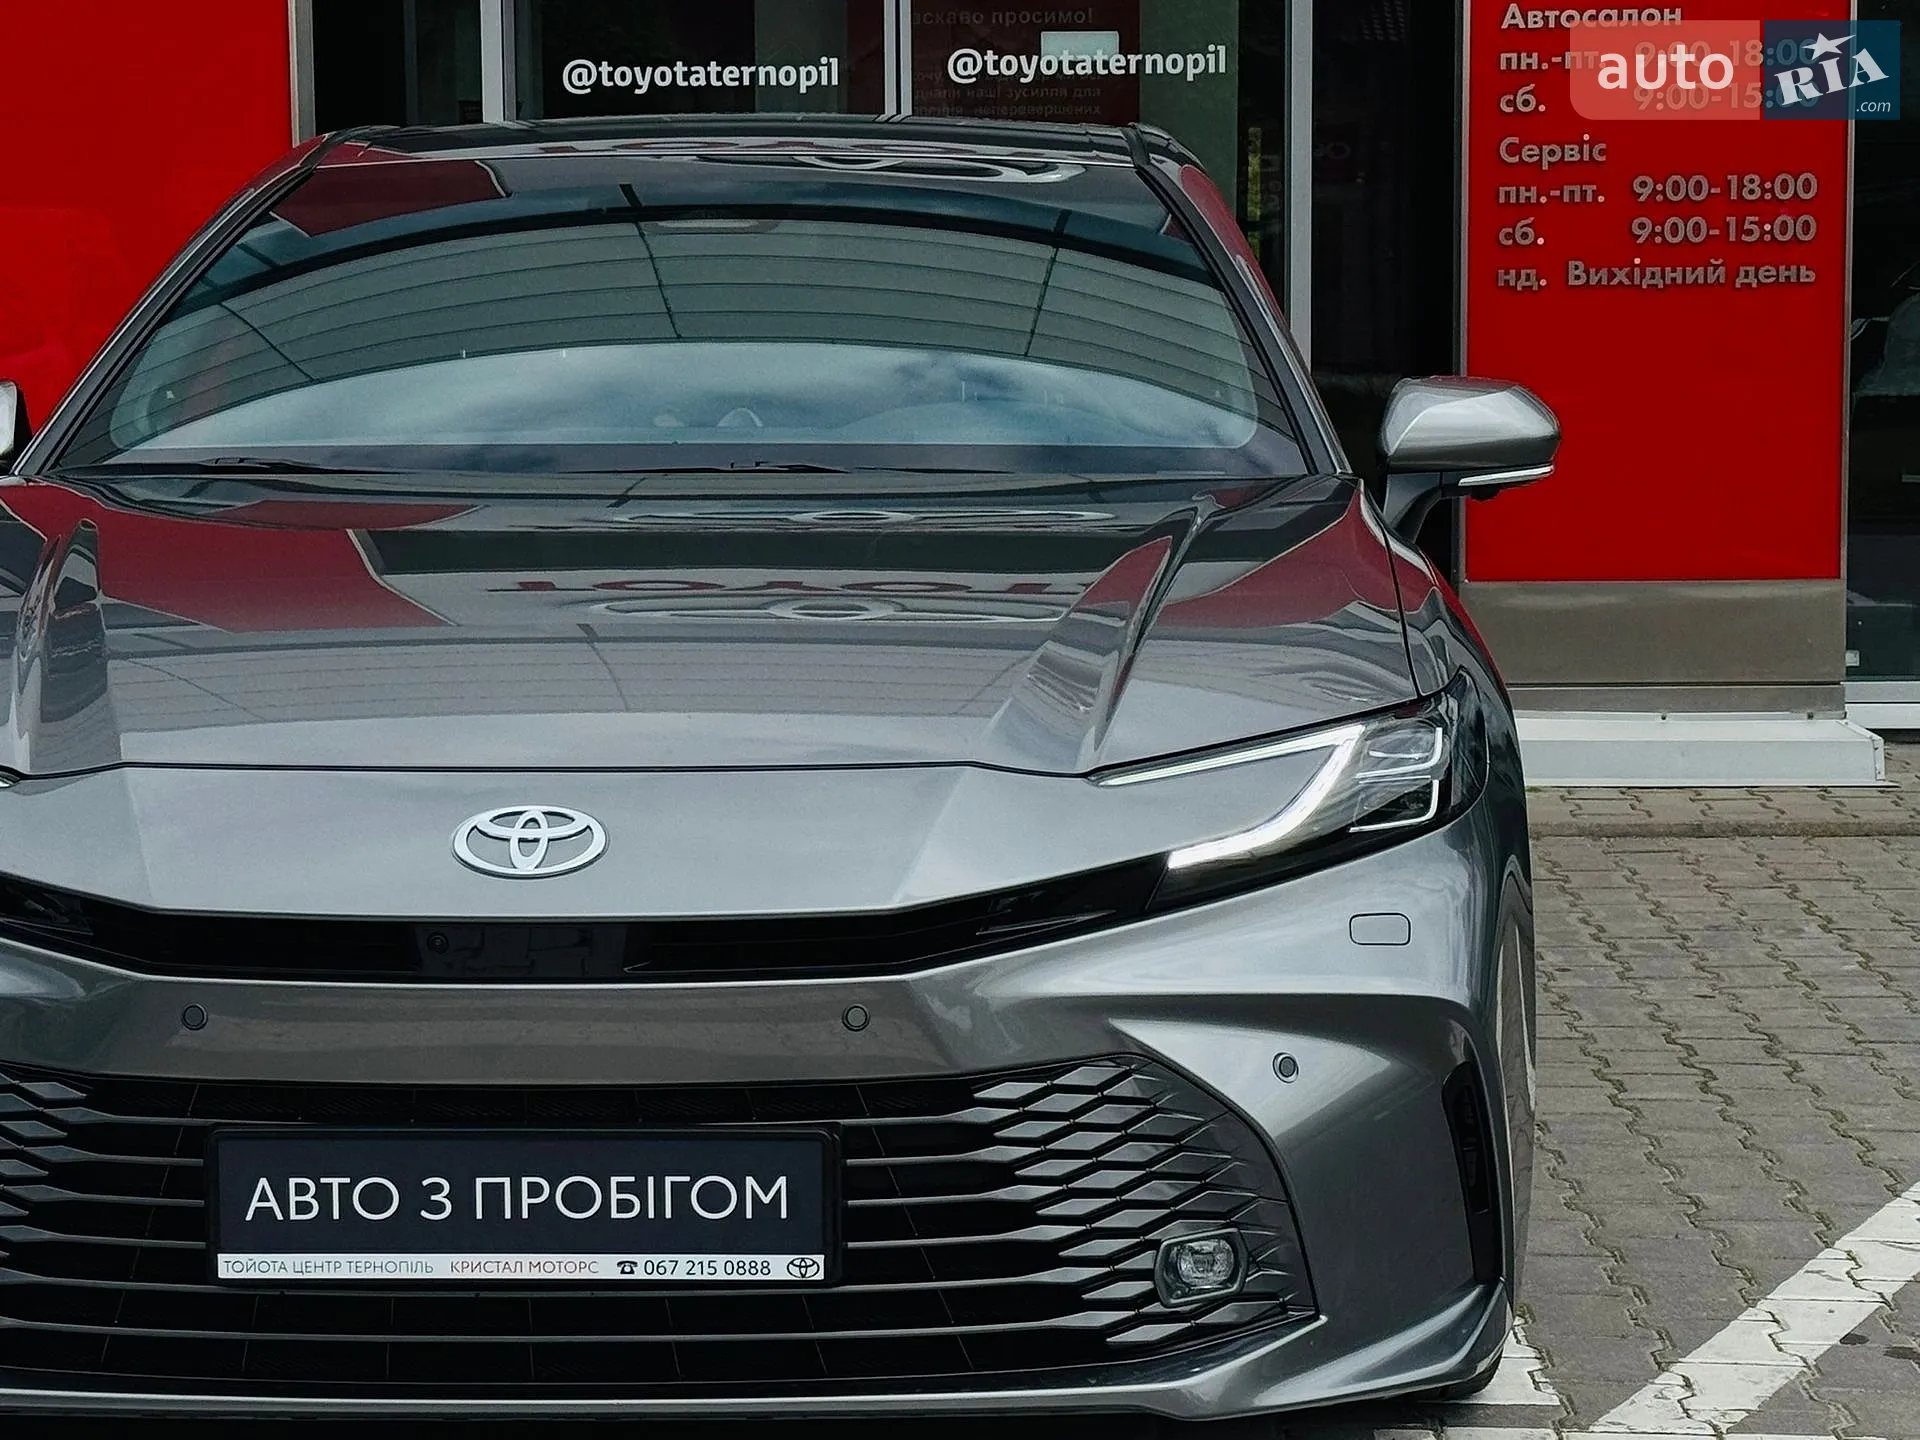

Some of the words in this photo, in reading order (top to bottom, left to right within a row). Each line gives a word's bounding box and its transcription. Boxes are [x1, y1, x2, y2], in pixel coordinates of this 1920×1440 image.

[991, 8, 1093, 27] просимо!
[1500, 3, 1682, 29] Автосалон
[947, 44, 1227, 84] @toyotaternopil
[1634, 38, 1820, 70] 9:0018:00
[562, 57, 839, 95] @toyotaternopil
[1500, 83, 1546, 113] сб.
[1499, 133, 1607, 170] Сервіс
[1498, 183, 1605, 205] пн.-пт.
[1632, 172, 1818, 202] 9:00-18:00
[1498, 216, 1545, 246] сб.
[1631, 214, 1817, 244] 9:00-15:00
[1497, 267, 1548, 291] нд.
[1567, 257, 1727, 289] Вихідний
[1735, 262, 1817, 288] день
[244, 1176, 400, 1221] АВТО
[419, 1176, 453, 1220] З
[474, 1175, 788, 1220] ПРОБІГОМ
[223, 1258, 288, 1274] ТОЙОТА
[292, 1259, 343, 1276] ЦЕНТР
[346, 1259, 434, 1275] ТЕРНОПІЛЬ
[450, 1259, 523, 1274] КРИСТАЛ
[529, 1260, 599, 1275] МОТОРС
[643, 1259, 679, 1276] 067
[685, 1259, 718, 1276] 215
[723, 1259, 772, 1276] 0888
